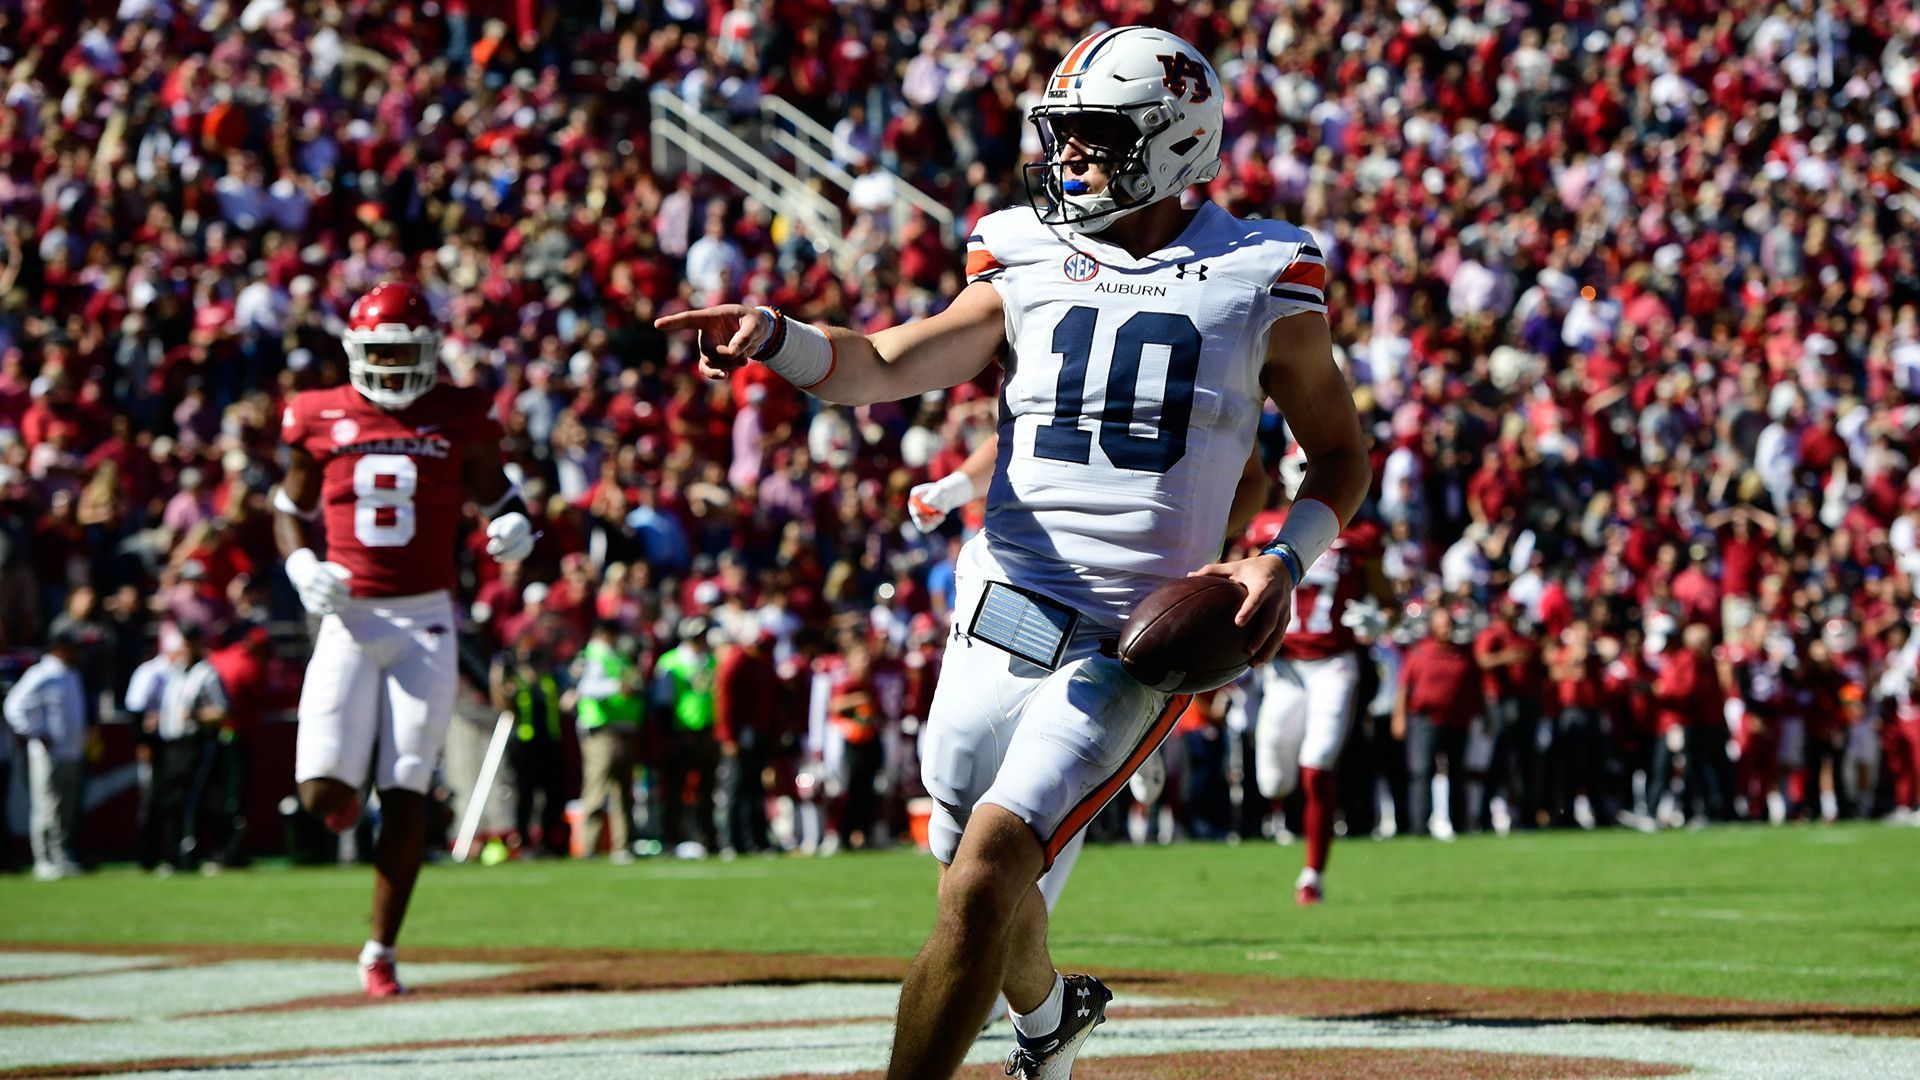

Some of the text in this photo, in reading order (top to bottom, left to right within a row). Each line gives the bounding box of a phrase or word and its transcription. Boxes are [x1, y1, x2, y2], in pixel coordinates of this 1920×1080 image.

[1065, 253, 1098, 281] SEC
[1094, 282, 1167, 297] AUBURN
[1033, 305, 1203, 474] 10
[331, 438, 452, 460] ANSAS
[353, 454, 418, 547] 8
